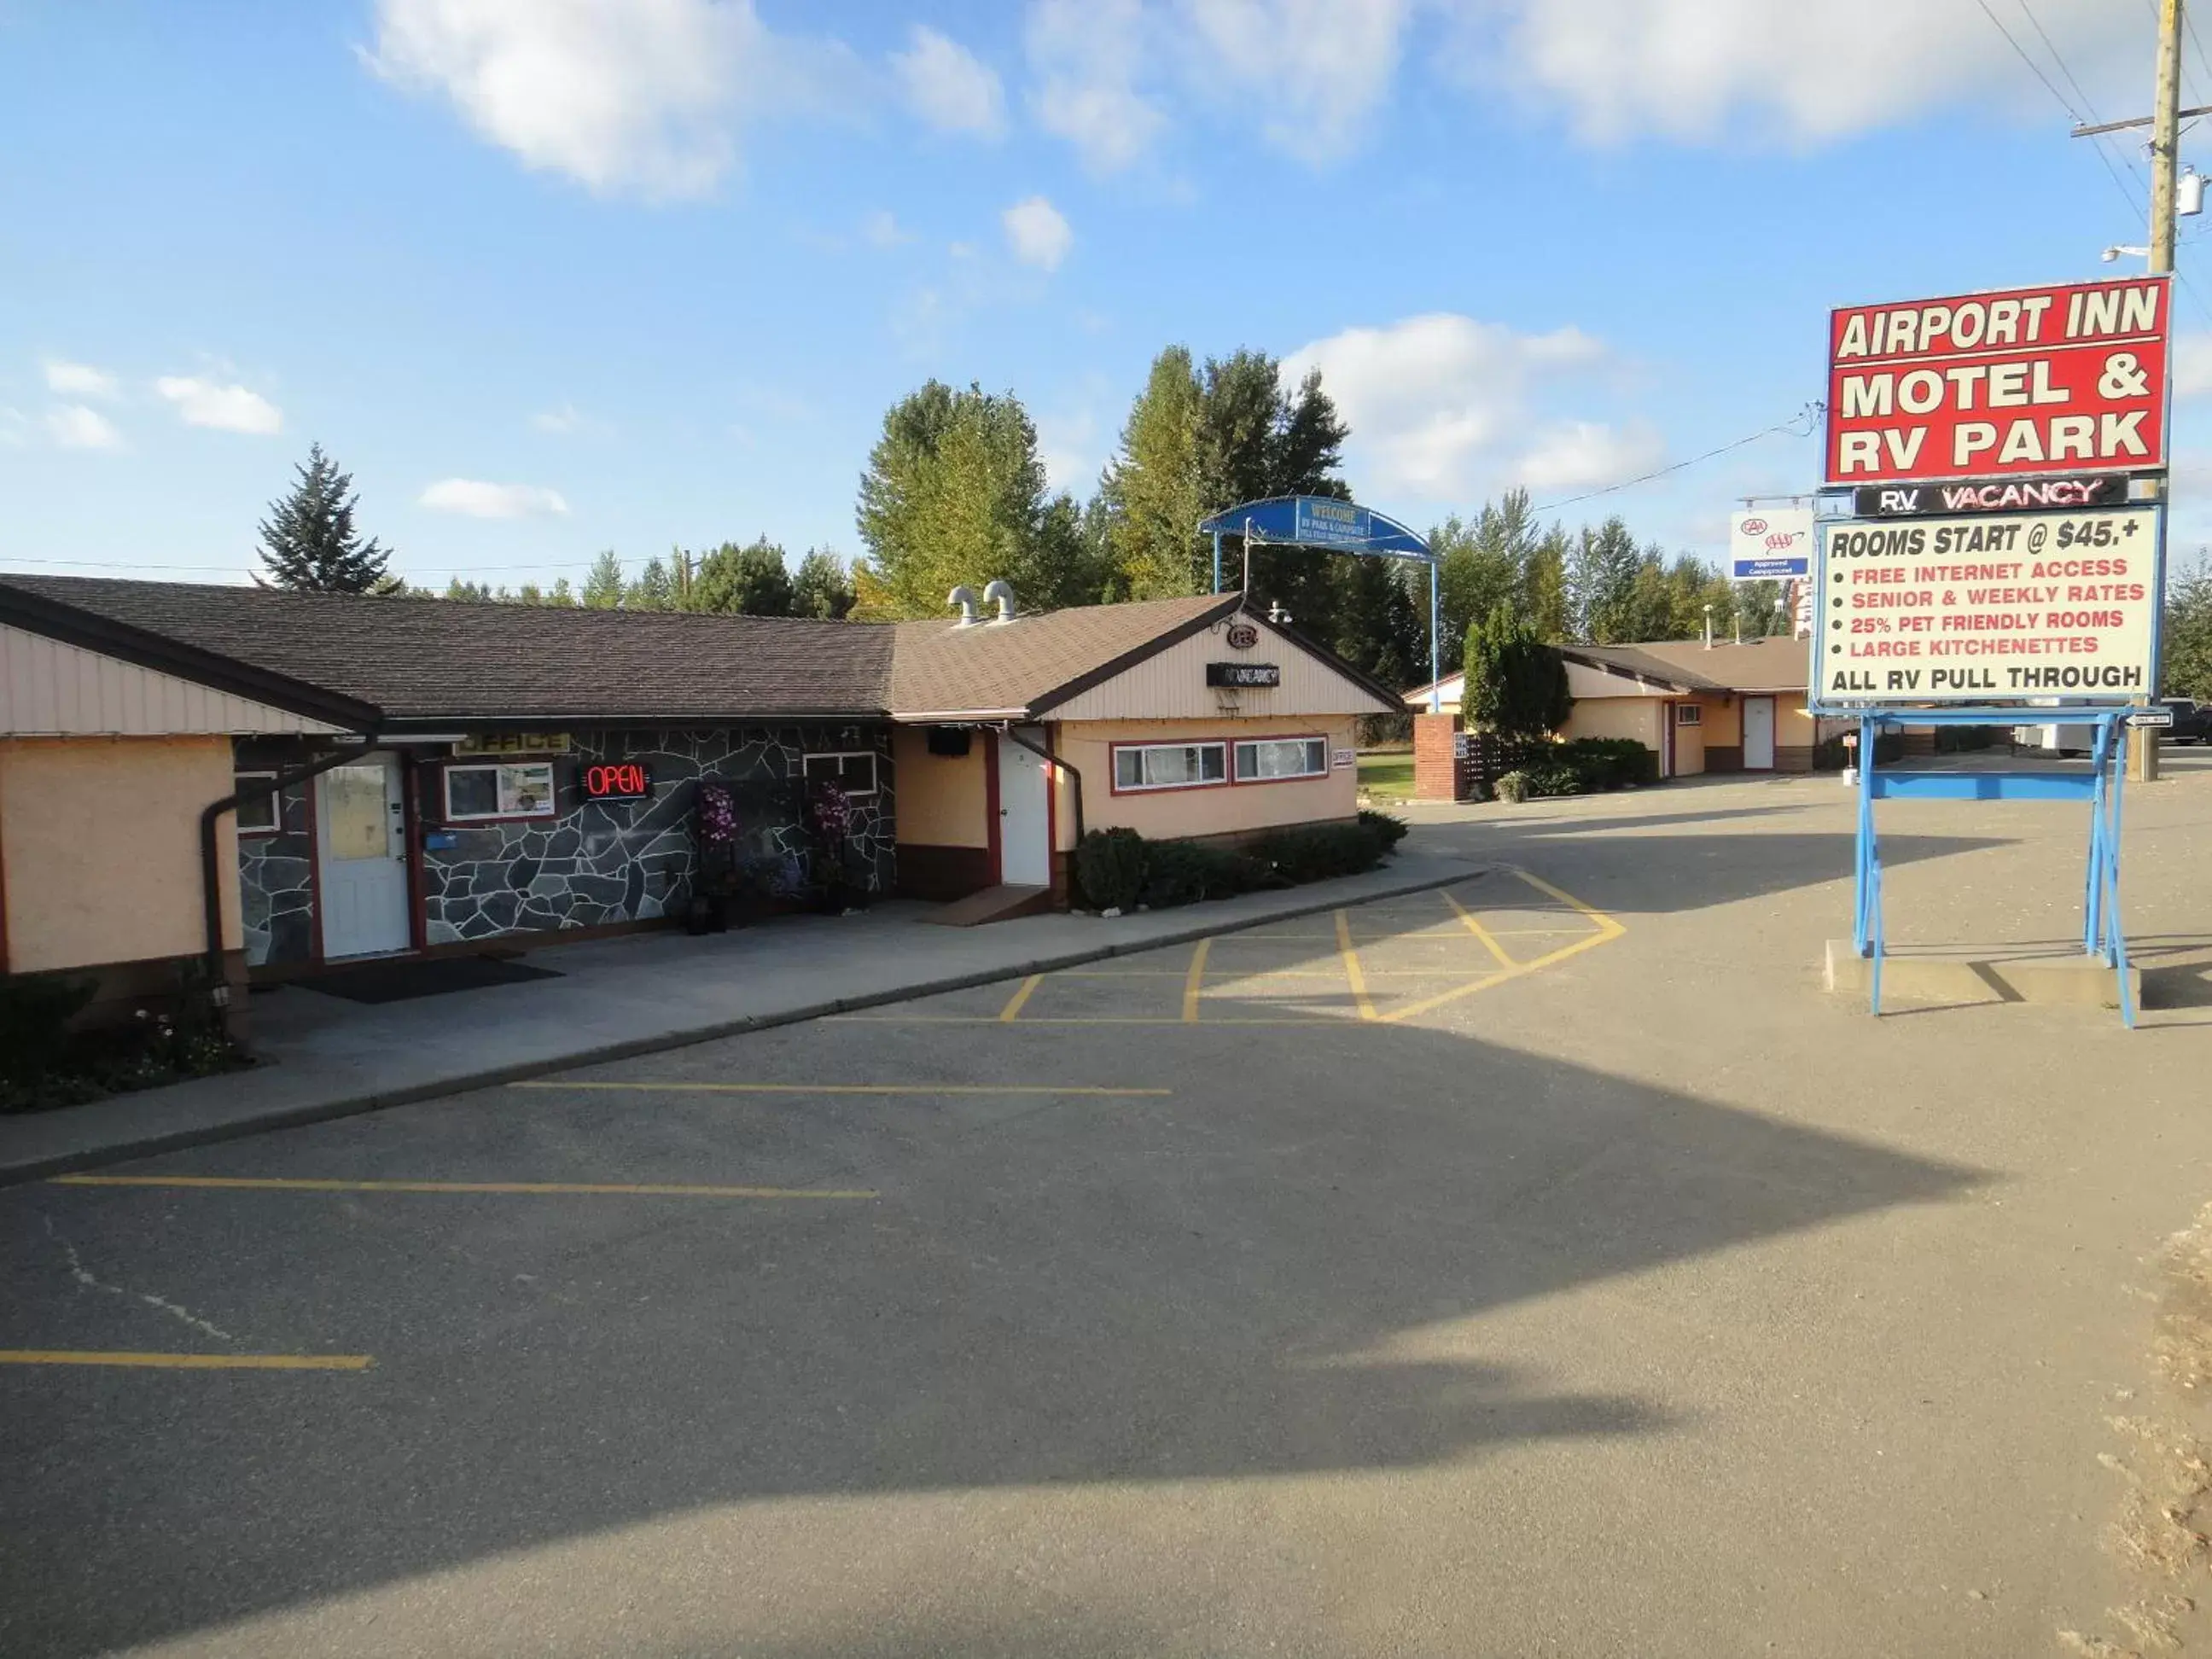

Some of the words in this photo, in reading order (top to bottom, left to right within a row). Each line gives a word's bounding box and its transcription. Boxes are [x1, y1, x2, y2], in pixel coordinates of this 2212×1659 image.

[1837, 295, 2052, 358] AIRPORT
[2065, 285, 2160, 339] INN
[1841, 359, 2071, 419] MOTEL
[2096, 351, 2151, 400] &
[1839, 426, 1928, 475] RV
[1953, 410, 2150, 468] PARK
[1941, 479, 2104, 509] VACANCY
[1831, 529, 1925, 558] ROOMS
[1933, 524, 2021, 555] START
[2027, 522, 2048, 555] @
[1852, 568, 1906, 585] FREE
[1914, 562, 2023, 582] INTERNET
[2030, 558, 2128, 579] ACCESS
[1851, 591, 1933, 609] SENIOR
[1941, 590, 1957, 606] &
[1967, 585, 2059, 605] WEEKLY
[2068, 583, 2145, 602] RATES
[1850, 617, 1892, 634] 25%
[1899, 615, 1935, 632] PET
[1941, 611, 2040, 632] FRIENDLY
[2046, 609, 2124, 628] ROOMS
[1850, 640, 1922, 658] LARGE
[1929, 637, 2099, 656] KITCHENETTES
[1831, 670, 1877, 690] ALL
[1887, 668, 1921, 690] RV
[1930, 667, 1997, 689] PULL
[2007, 666, 2142, 688] THROUGH
[588, 765, 643, 795] OPEN
